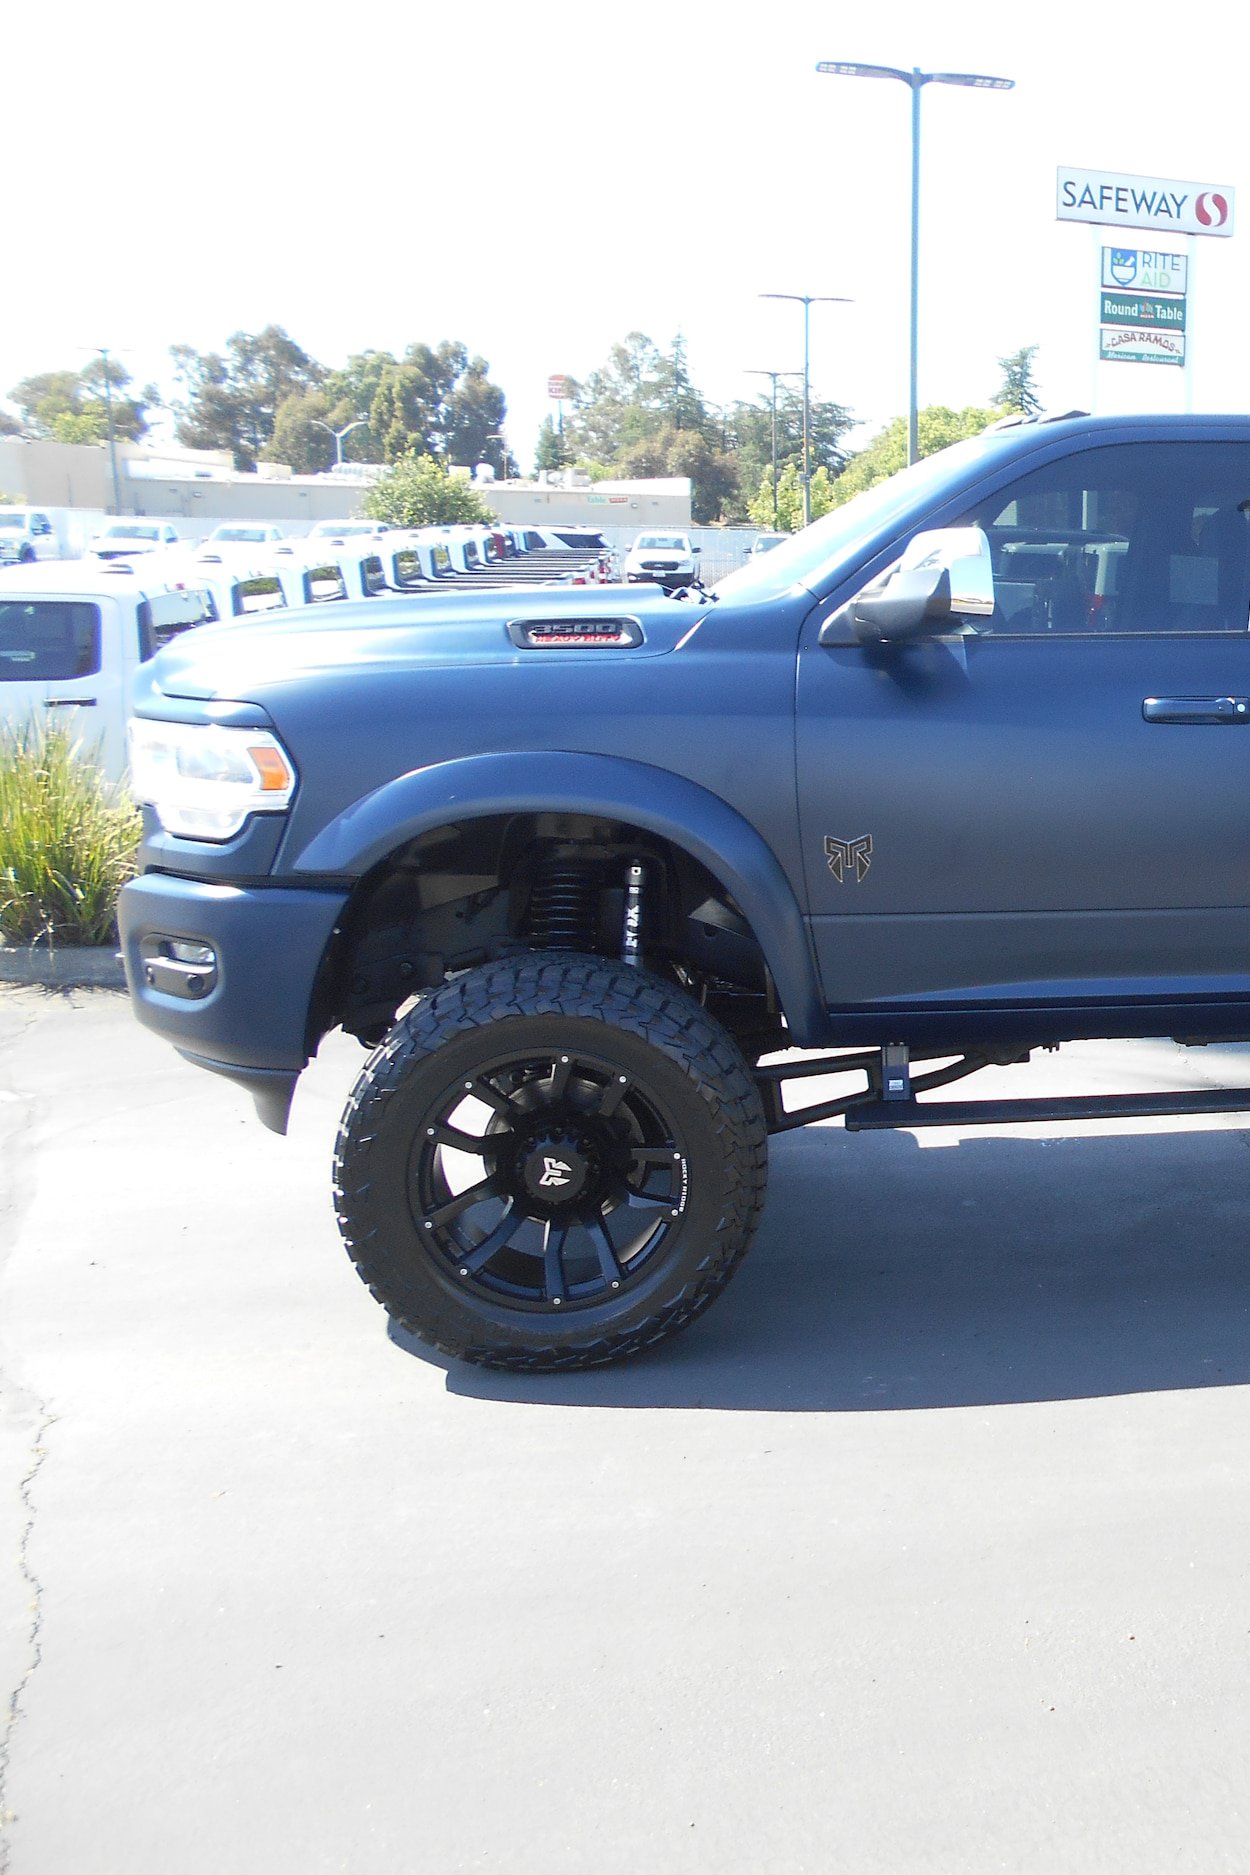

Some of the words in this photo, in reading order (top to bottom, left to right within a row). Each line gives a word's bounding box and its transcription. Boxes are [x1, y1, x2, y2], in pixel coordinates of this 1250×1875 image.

[1062, 181, 1188, 219] SAFEWAY
[1142, 251, 1181, 271] RITE
[1141, 272, 1170, 288] AID
[1104, 300, 1138, 316] Round
[1155, 304, 1183, 320] Table
[1111, 332, 1136, 347] CASA
[1138, 332, 1176, 352] RAMOS
[531, 624, 616, 633] 3500
